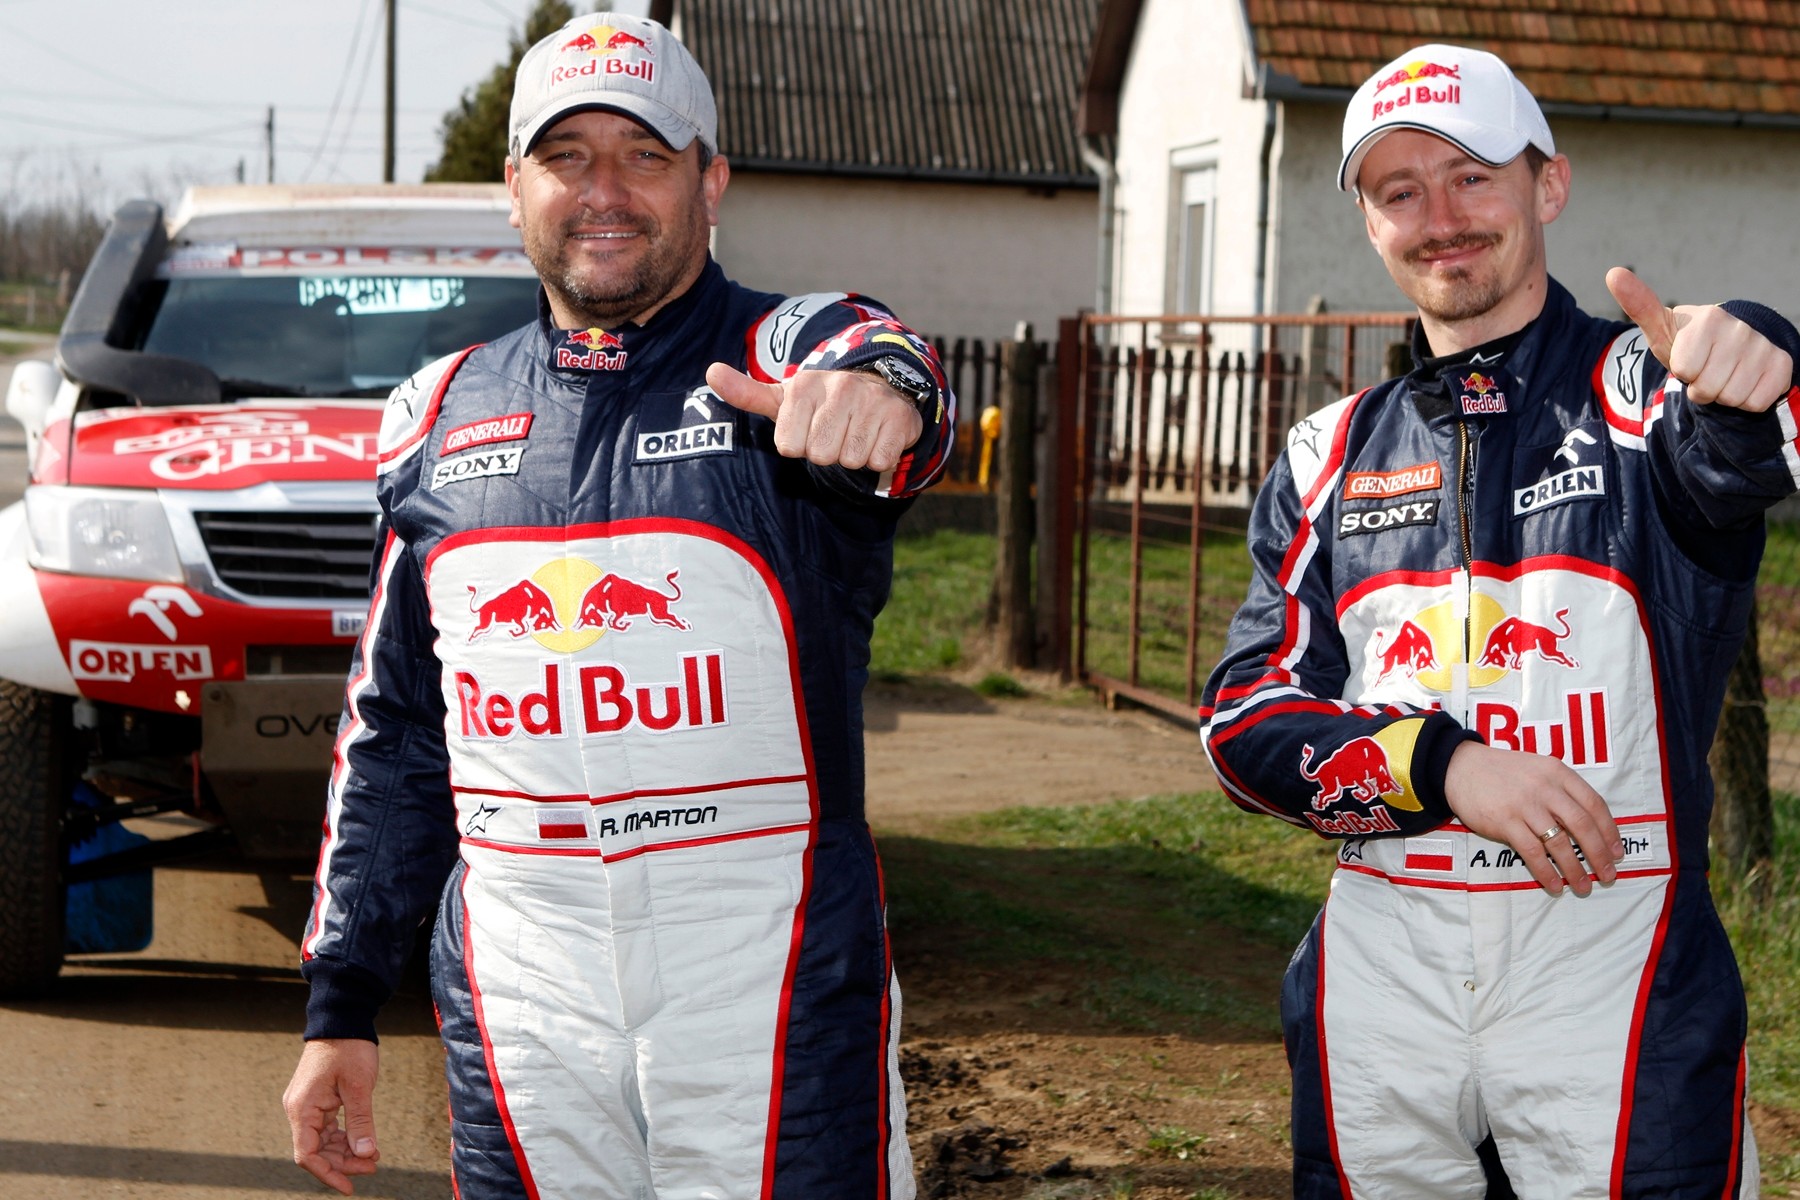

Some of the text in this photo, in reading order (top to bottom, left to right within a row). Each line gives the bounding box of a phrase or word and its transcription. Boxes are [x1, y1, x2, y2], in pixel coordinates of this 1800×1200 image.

[551, 58, 654, 87] Red Bull
[1372, 84, 1460, 121] Red Bull
[557, 348, 627, 370] Red Bull
[1461, 393, 1507, 414] Red Bull
[446, 417, 527, 450] GENERALI
[643, 426, 726, 455] ORLEN
[1351, 467, 1437, 494] GENERALI
[1520, 470, 1598, 509] ORLEN
[79, 648, 203, 675] ORLEN
[454, 654, 725, 738] Red Bull
[1476, 691, 1609, 766] Bull
[600, 806, 718, 838] R. MARTON
[1303, 805, 1401, 834] Red Bull
[1470, 849, 1491, 868] A.
